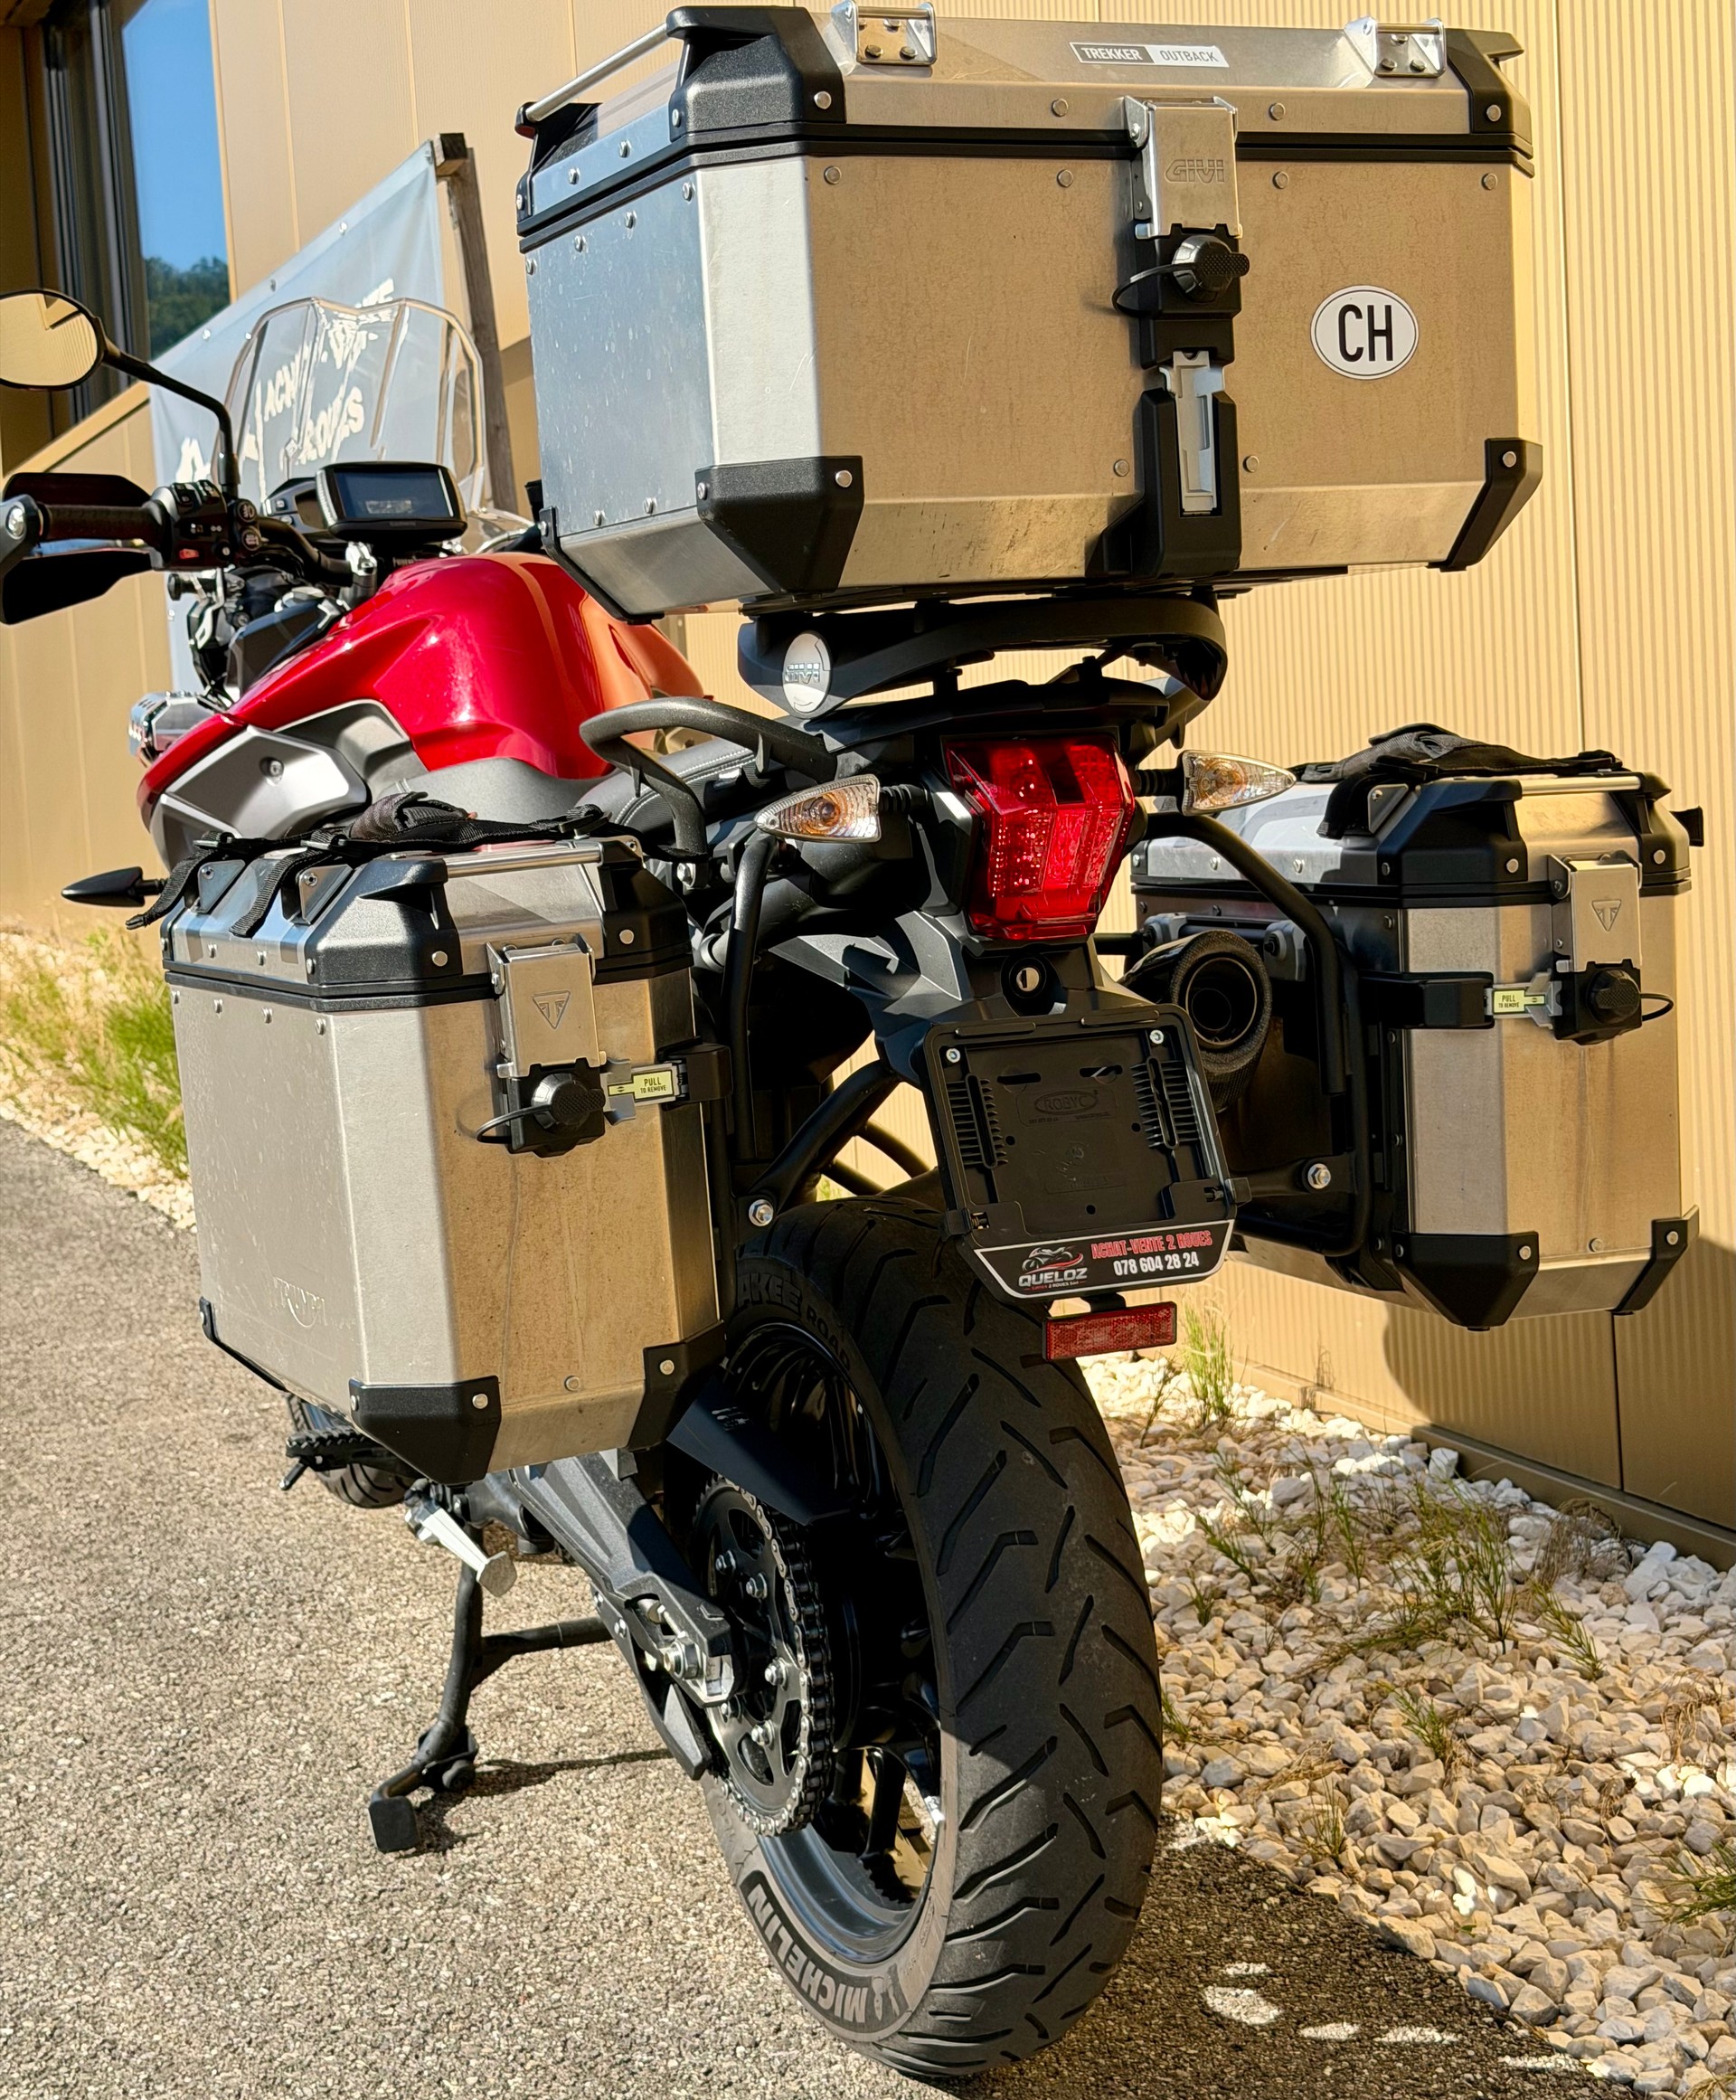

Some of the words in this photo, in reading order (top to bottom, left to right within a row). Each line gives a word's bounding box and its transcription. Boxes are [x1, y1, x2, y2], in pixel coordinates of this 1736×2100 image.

[1080, 47, 1143, 61] TREKKER
[1159, 50, 1220, 62] OUTBACK
[1165, 159, 1225, 184] GIVI
[1338, 304, 1394, 363] CH
[644, 1077, 661, 1087] PULL
[1090, 1235, 1165, 1259] ACHAT-VENTE
[1165, 1234, 1176, 1251] 2
[1176, 1230, 1212, 1249] ROUES
[1113, 1258, 1137, 1276] 078
[1139, 1255, 1164, 1273] 604
[1165, 1253, 1181, 1270] 28
[1183, 1251, 1200, 1268] 24
[1018, 1267, 1088, 1287] QUELOZ
[747, 1883, 869, 2023] MICHELIN
